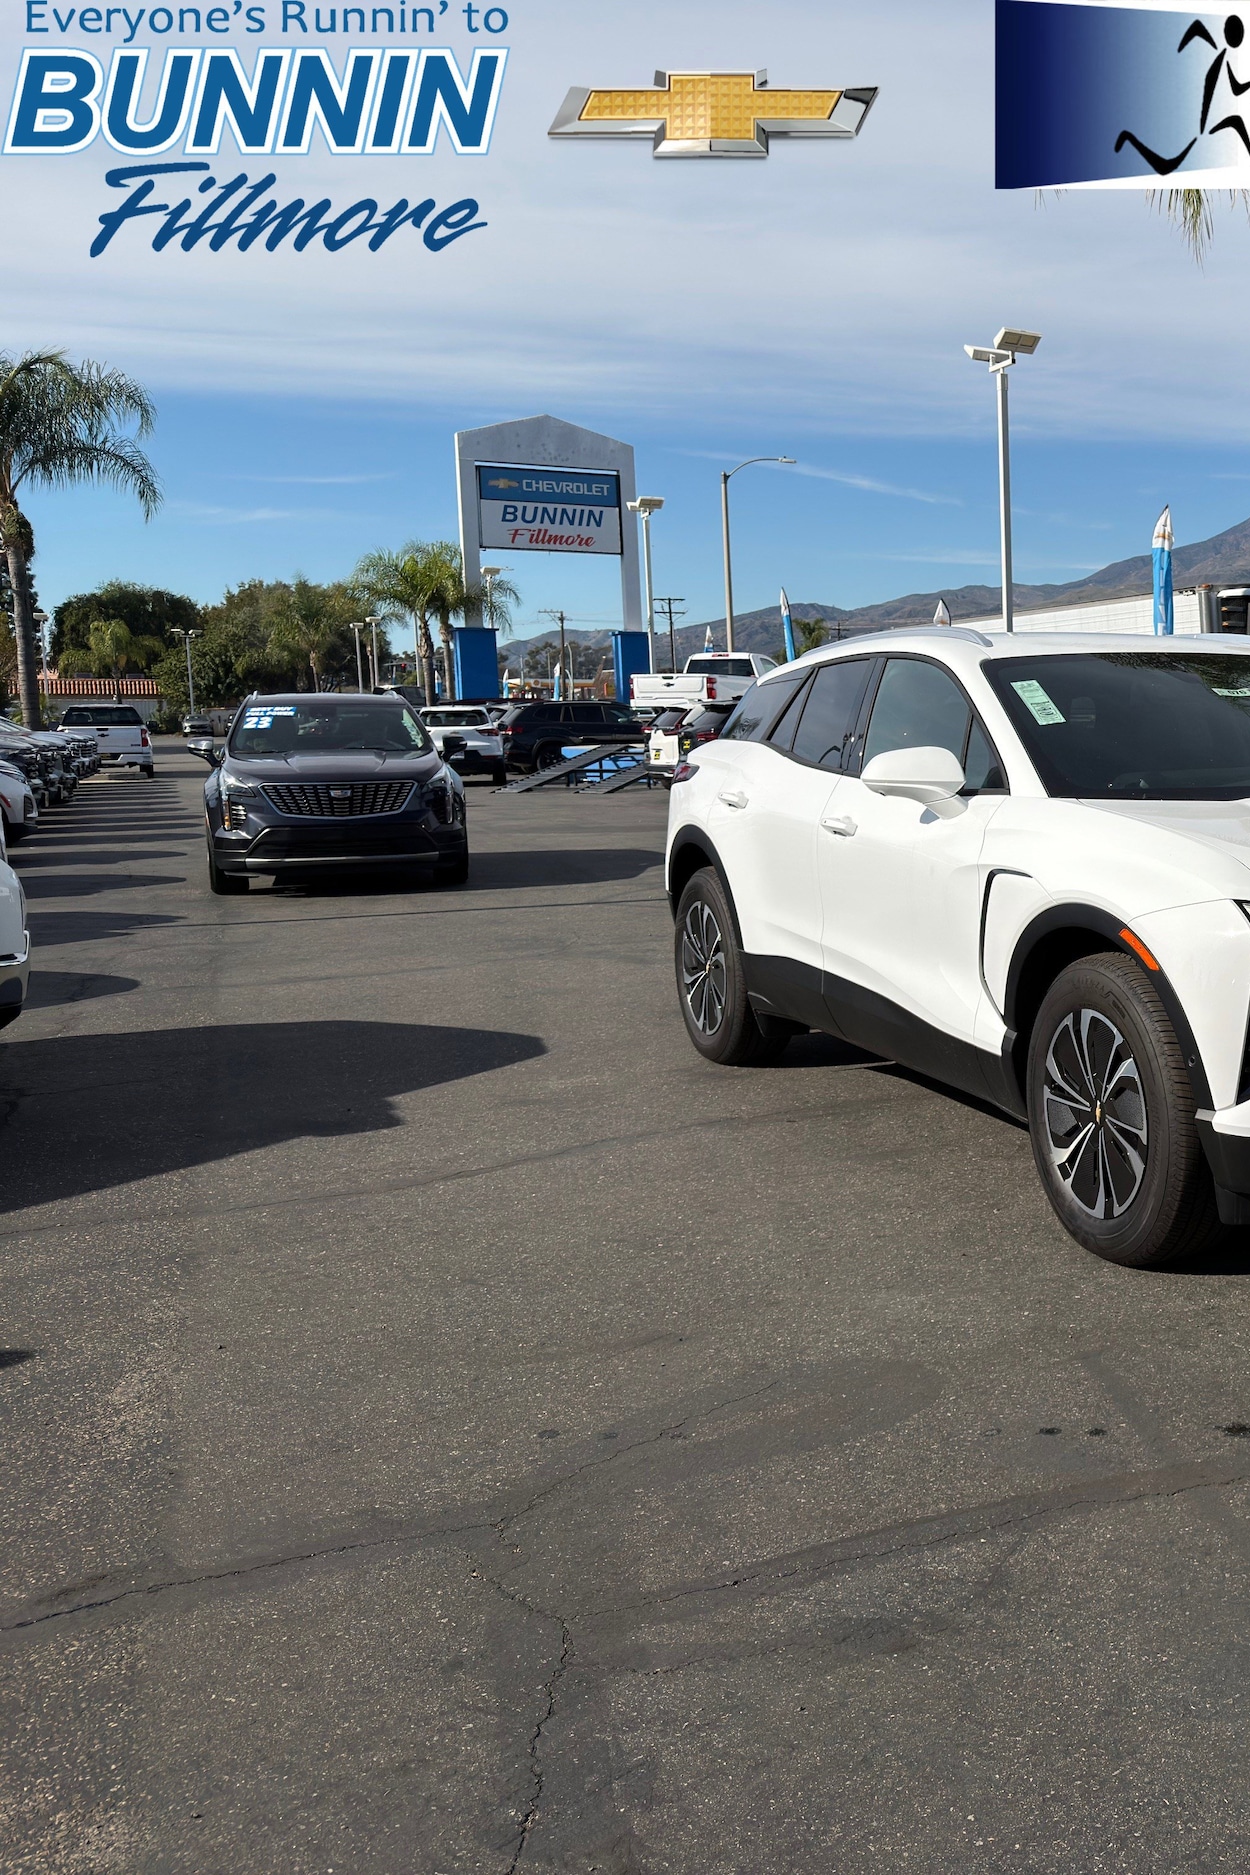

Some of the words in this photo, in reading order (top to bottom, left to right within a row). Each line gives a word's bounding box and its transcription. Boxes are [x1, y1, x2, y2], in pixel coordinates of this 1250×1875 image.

[522, 479, 610, 496] CHEVROLET
[501, 504, 604, 527] BUNNIN
[507, 527, 597, 548] Fillmore
[243, 716, 273, 729] 23
